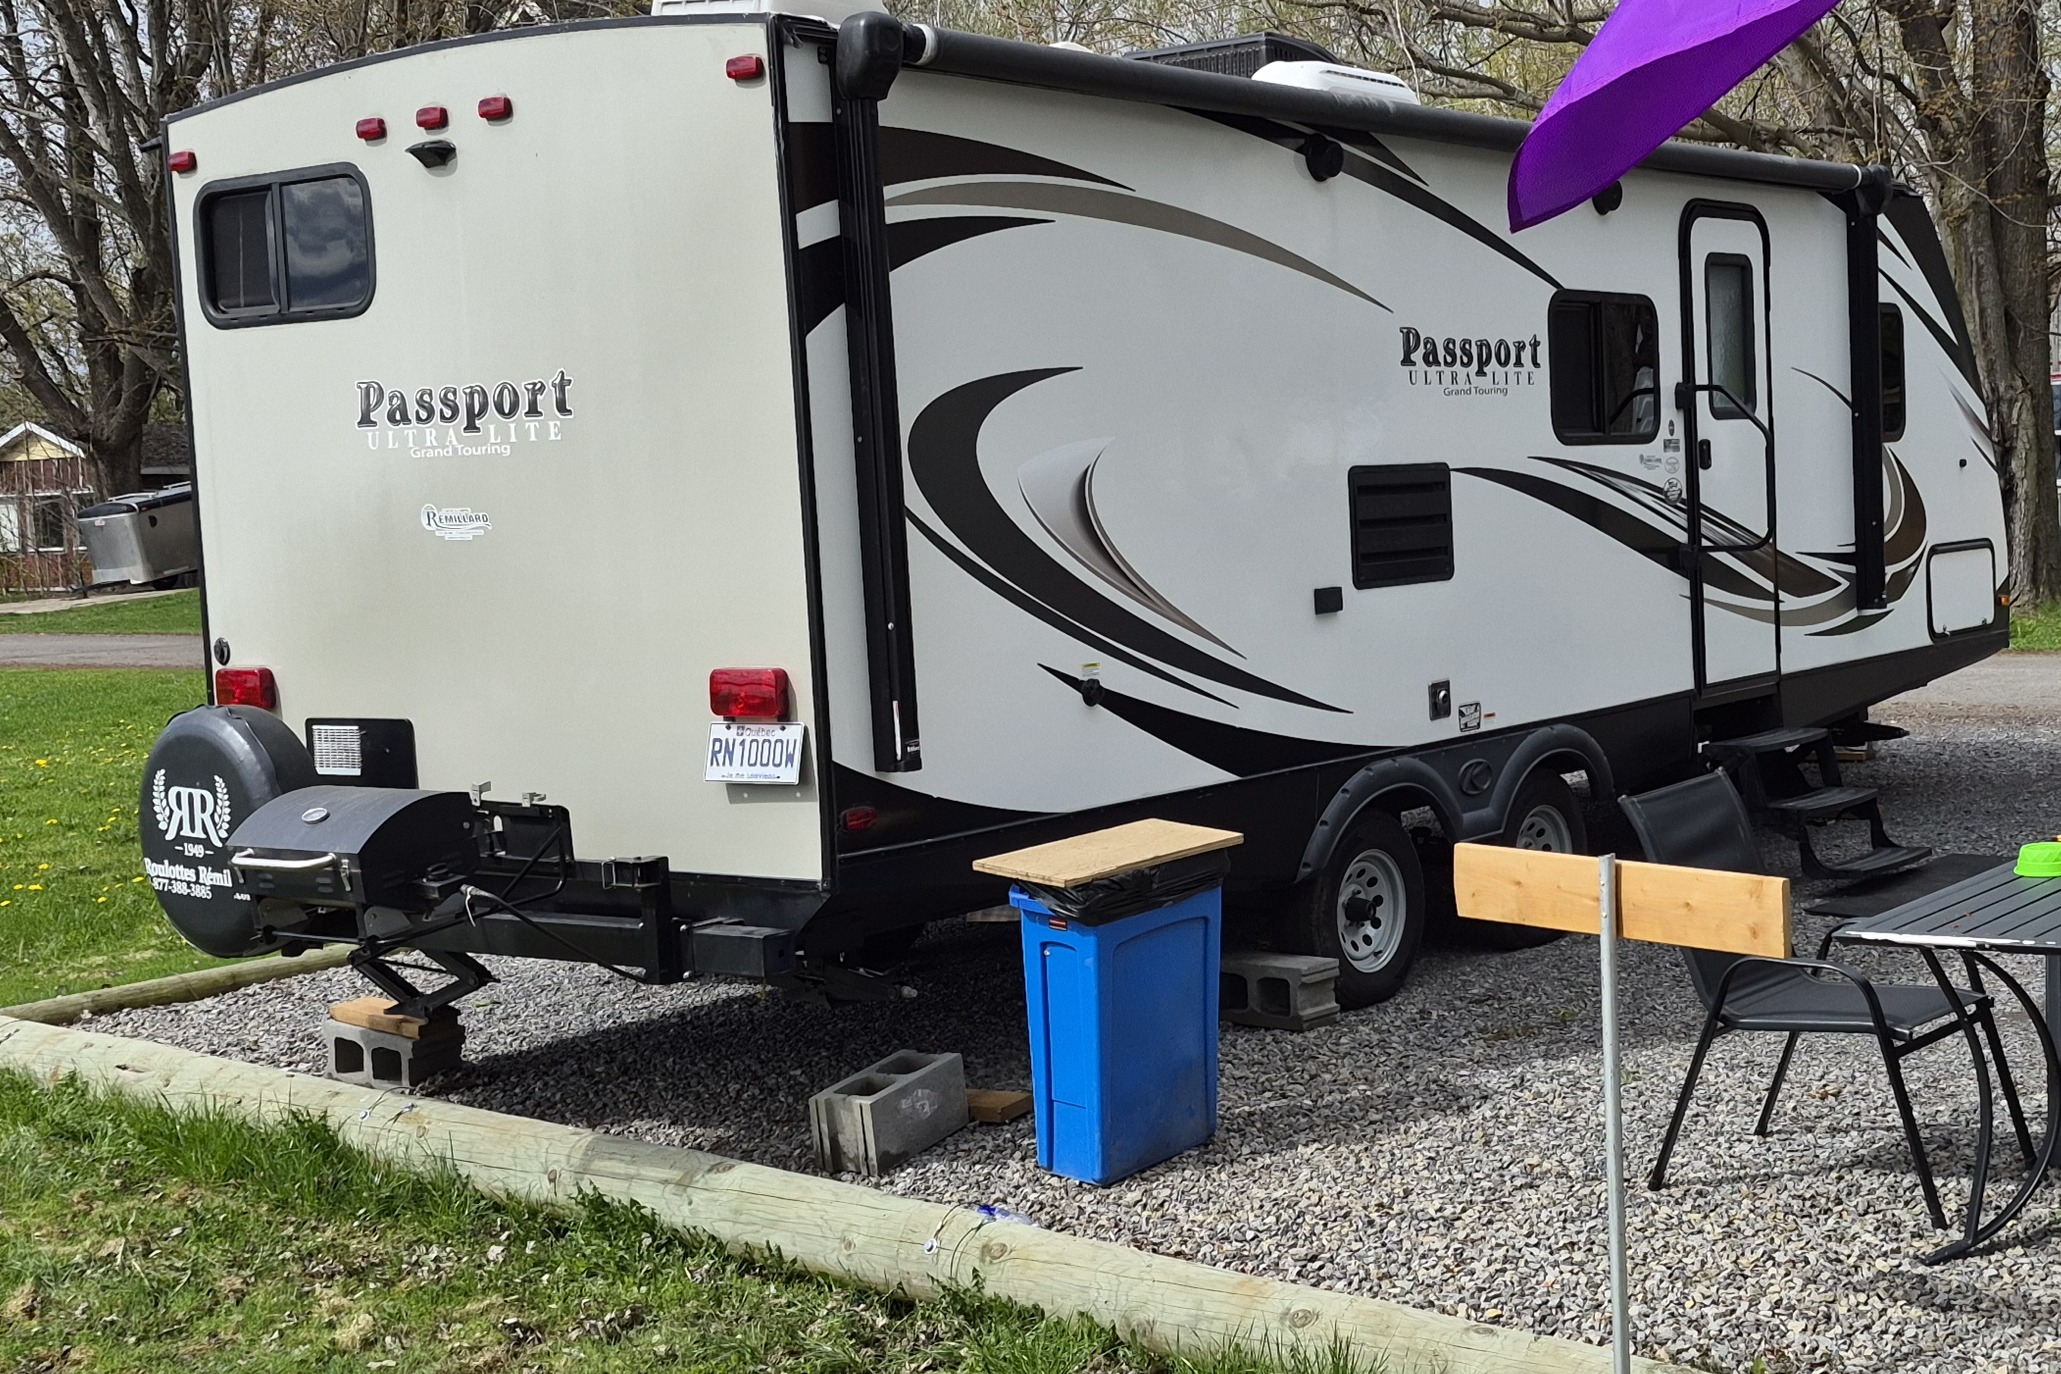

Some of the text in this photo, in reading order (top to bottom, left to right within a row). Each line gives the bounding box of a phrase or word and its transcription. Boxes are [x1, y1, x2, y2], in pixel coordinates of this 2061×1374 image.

[1399, 326, 1541, 377] Passport
[1408, 370, 1535, 385] ULTRA LITE
[1443, 386, 1508, 396] Grand Touring
[355, 369, 573, 434] Passport
[367, 421, 562, 450] ULTRA LITE
[410, 443, 511, 458] Grand Touring
[426, 510, 489, 527] REMILLARD
[710, 738, 797, 768] RN1000W
[143, 857, 233, 887] Roulottes Rémil
